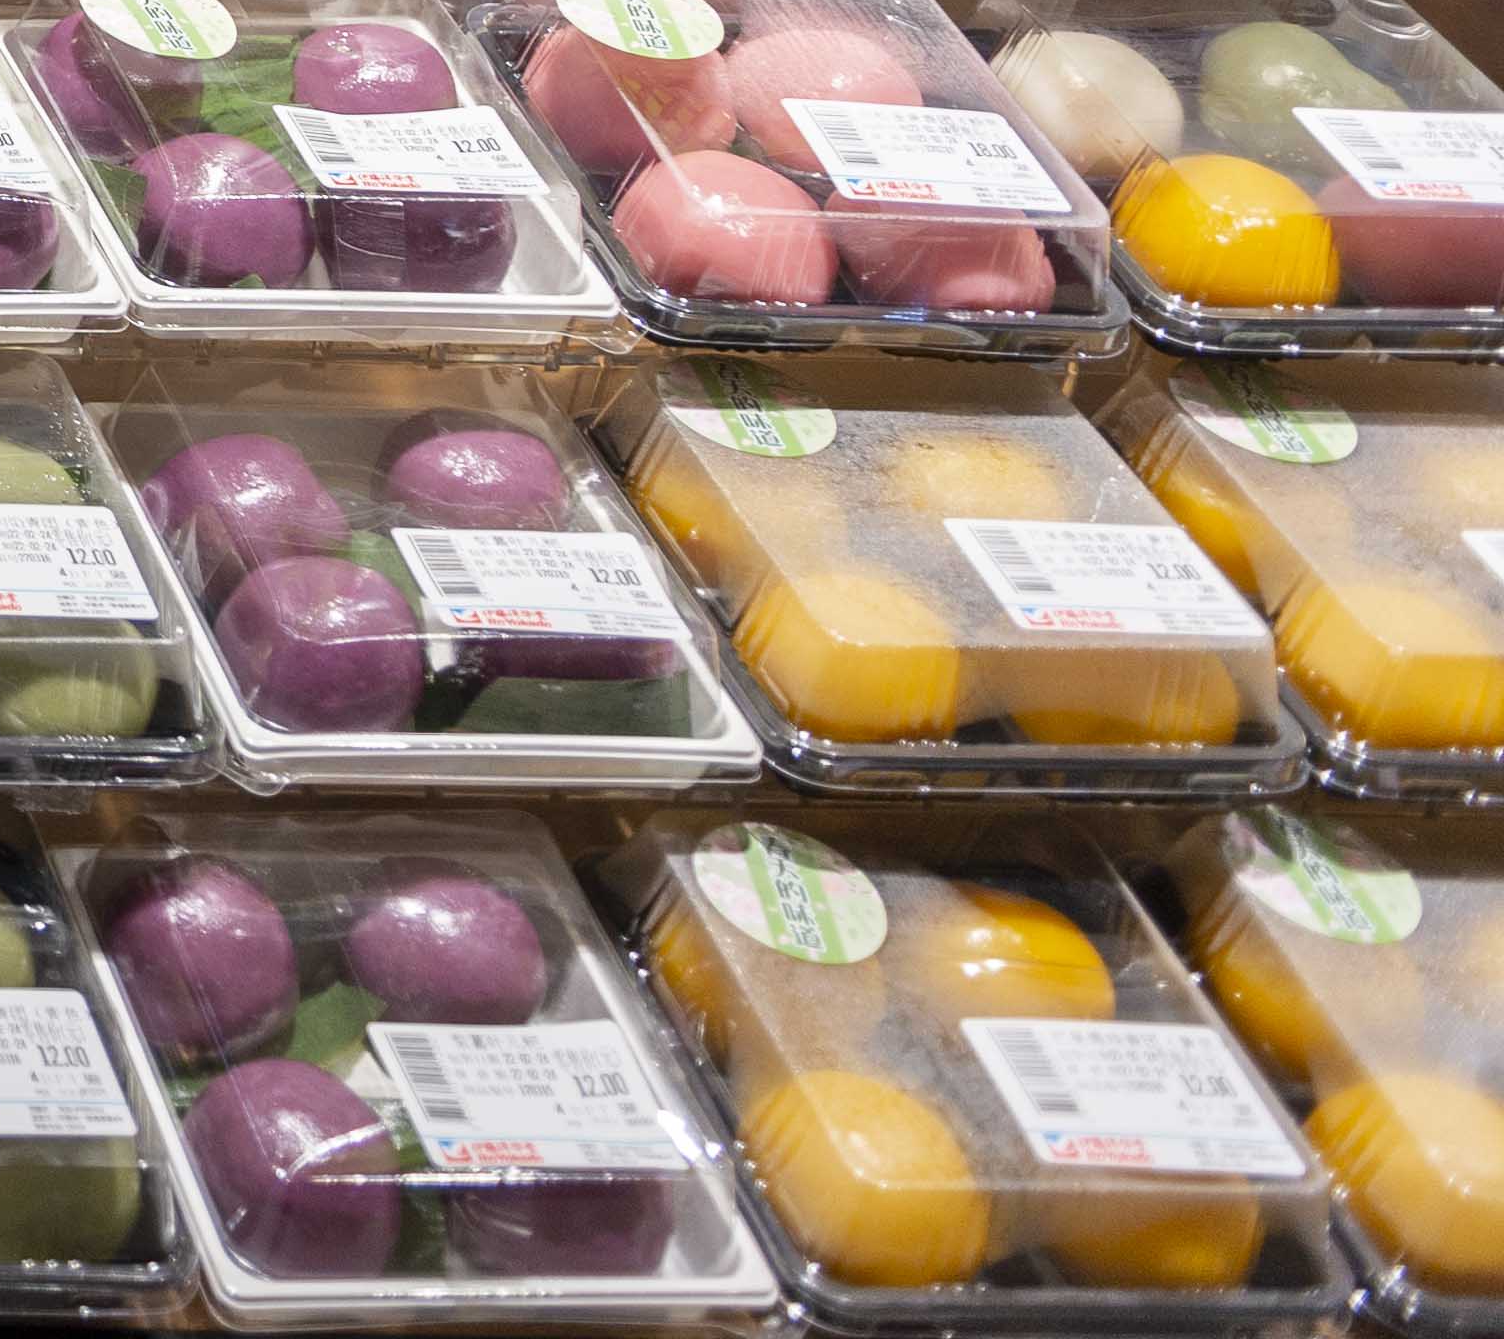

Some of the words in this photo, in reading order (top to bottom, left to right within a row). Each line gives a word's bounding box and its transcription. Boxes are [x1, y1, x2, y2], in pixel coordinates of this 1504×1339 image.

[453, 137, 499, 153] 12.00
[65, 548, 117, 566] 12.00
[586, 567, 642, 586] 12.00
[36, 1046, 90, 1068] 12.00
[573, 1073, 629, 1097] 12.00
